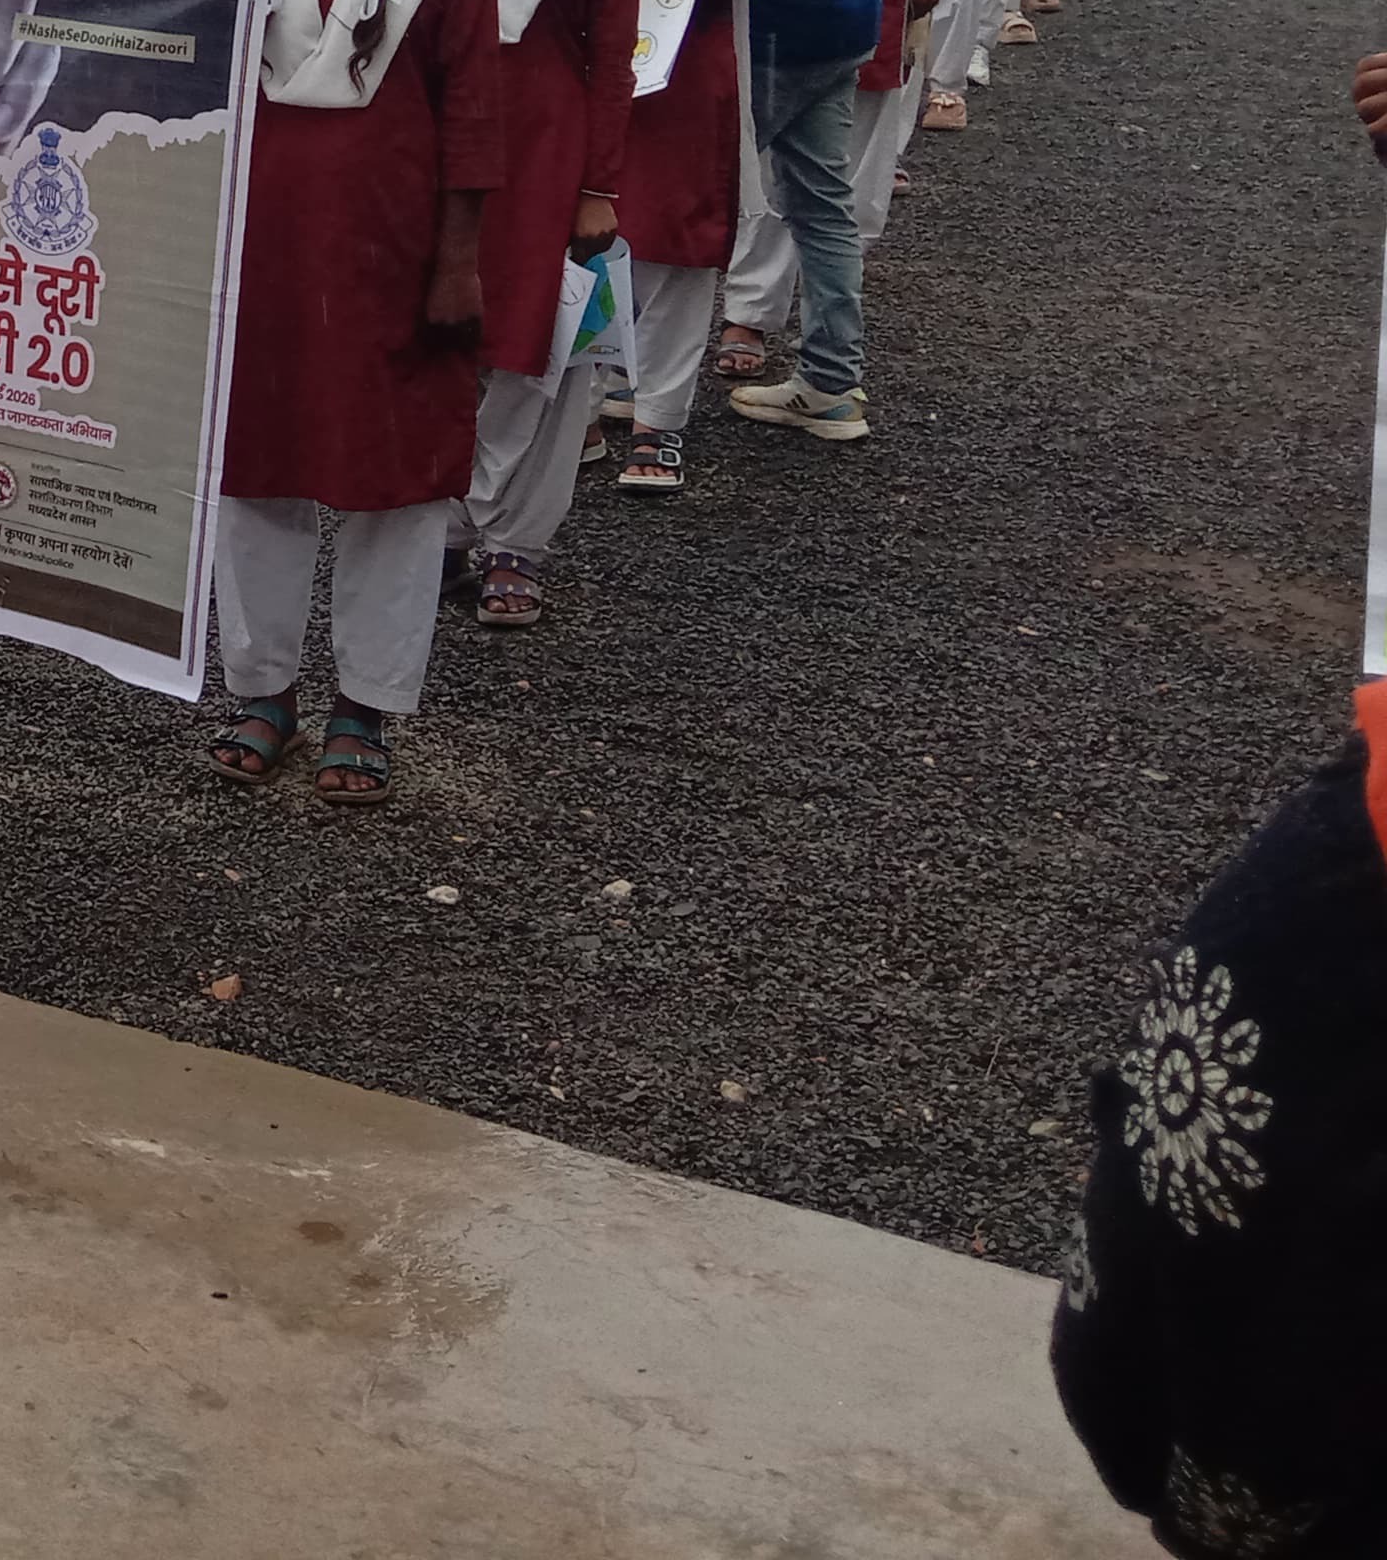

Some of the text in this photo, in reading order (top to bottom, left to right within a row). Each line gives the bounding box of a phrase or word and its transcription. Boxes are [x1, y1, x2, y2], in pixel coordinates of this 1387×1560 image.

[19, 22, 187, 56] #NasheSeDooriHaiZaroori
[34, 255, 100, 336] दूरी
[27, 335, 89, 387] 2.0
[7, 389, 36, 406] 2026
[66, 419, 112, 443] अभियान
[4, 524, 37, 547] कृपया
[38, 534, 69, 555] अपना
[71, 543, 111, 566] सहयोग
